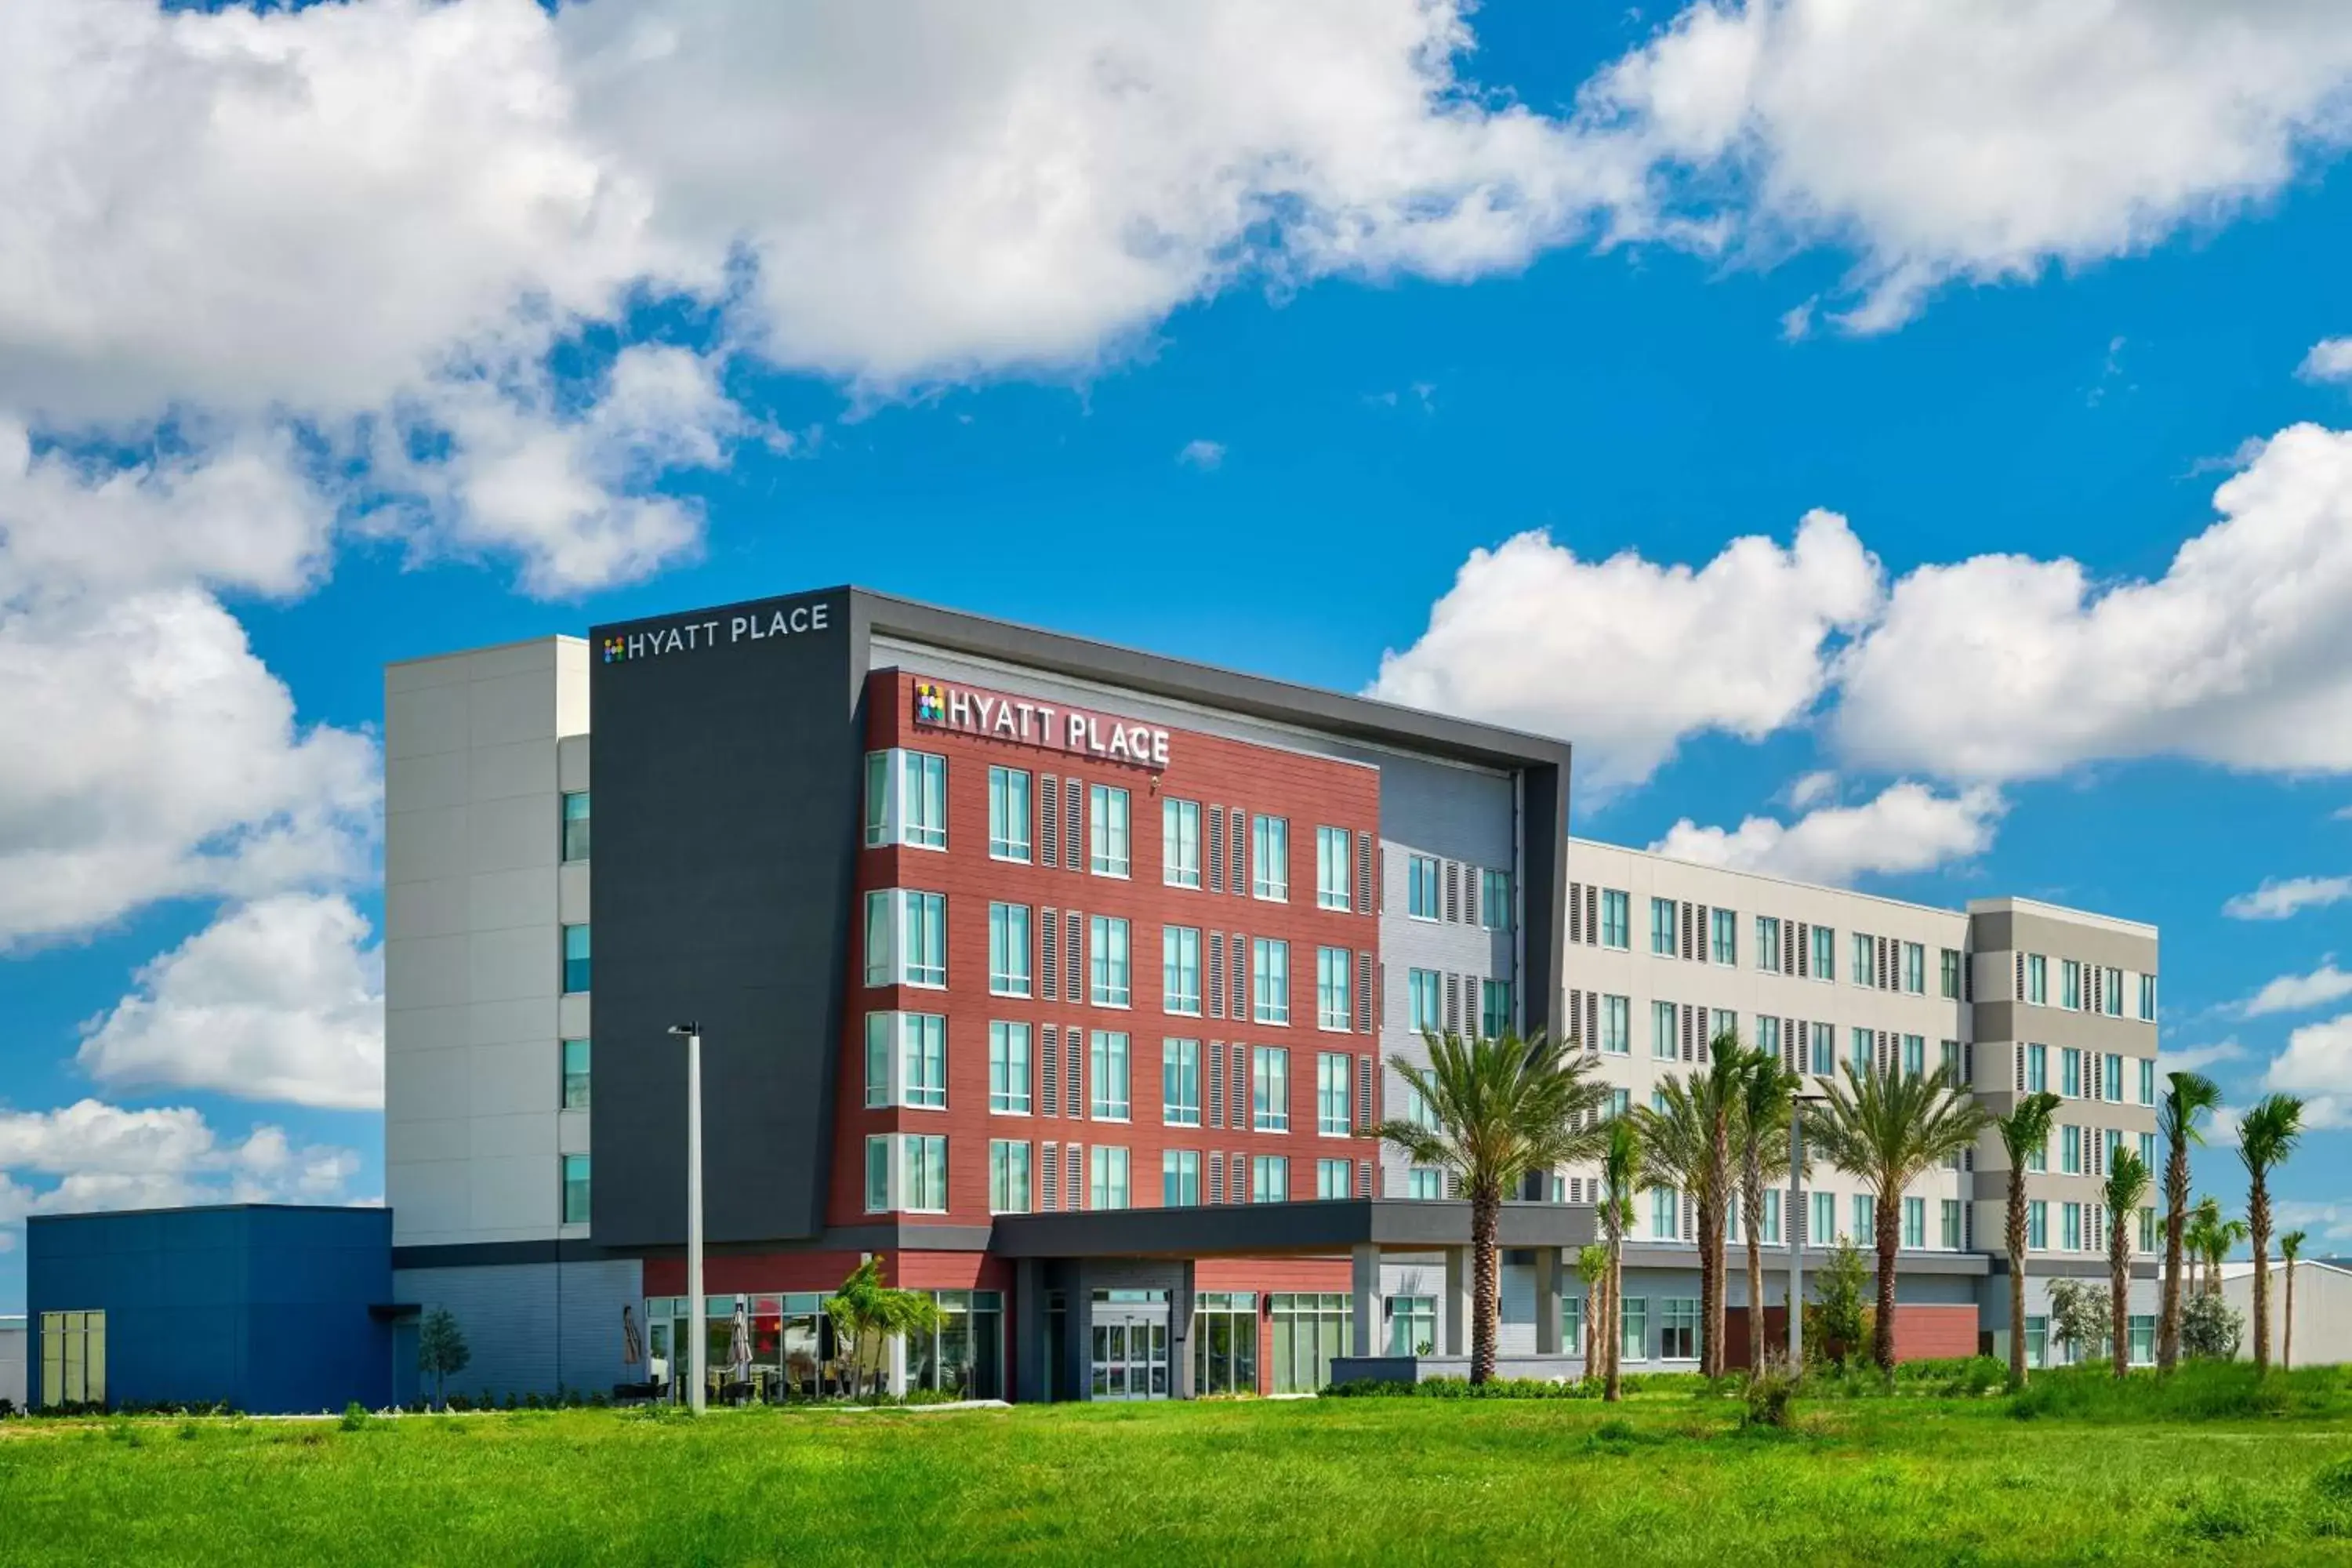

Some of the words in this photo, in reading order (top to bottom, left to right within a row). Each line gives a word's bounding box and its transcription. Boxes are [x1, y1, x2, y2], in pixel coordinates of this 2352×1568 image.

[628, 621, 720, 659] HYATT
[731, 603, 829, 643] PLACE
[949, 689, 1054, 741] HYATT
[1069, 713, 1170, 764] PLACE
